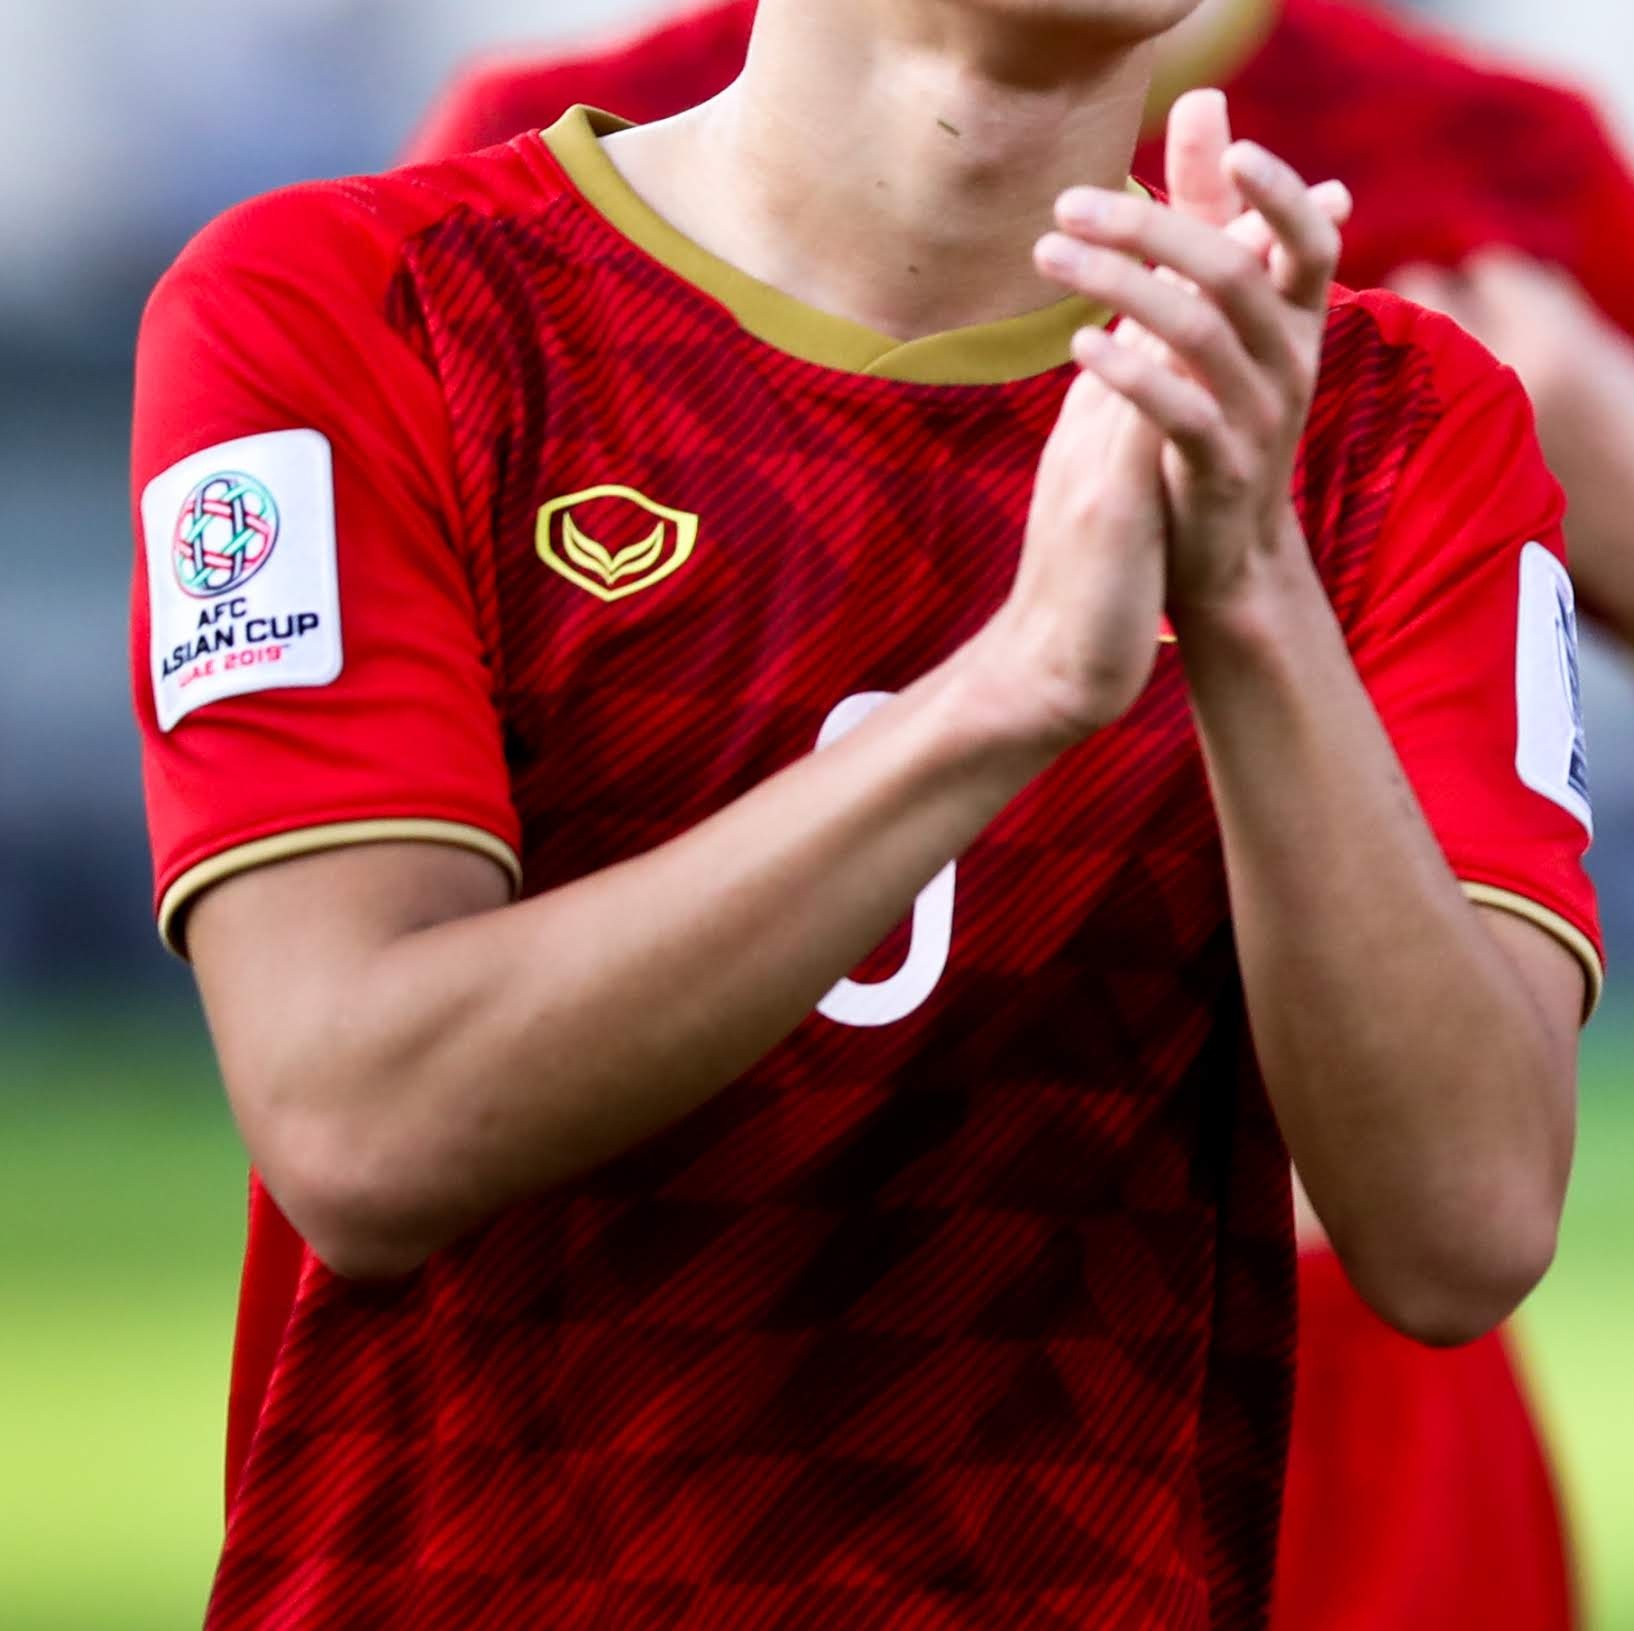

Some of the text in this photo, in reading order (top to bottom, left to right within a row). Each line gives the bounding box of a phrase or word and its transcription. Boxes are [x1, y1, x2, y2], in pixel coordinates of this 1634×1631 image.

[198, 597, 247, 629] AFC
[245, 612, 319, 643] CUP
[223, 644, 283, 670] 2019
